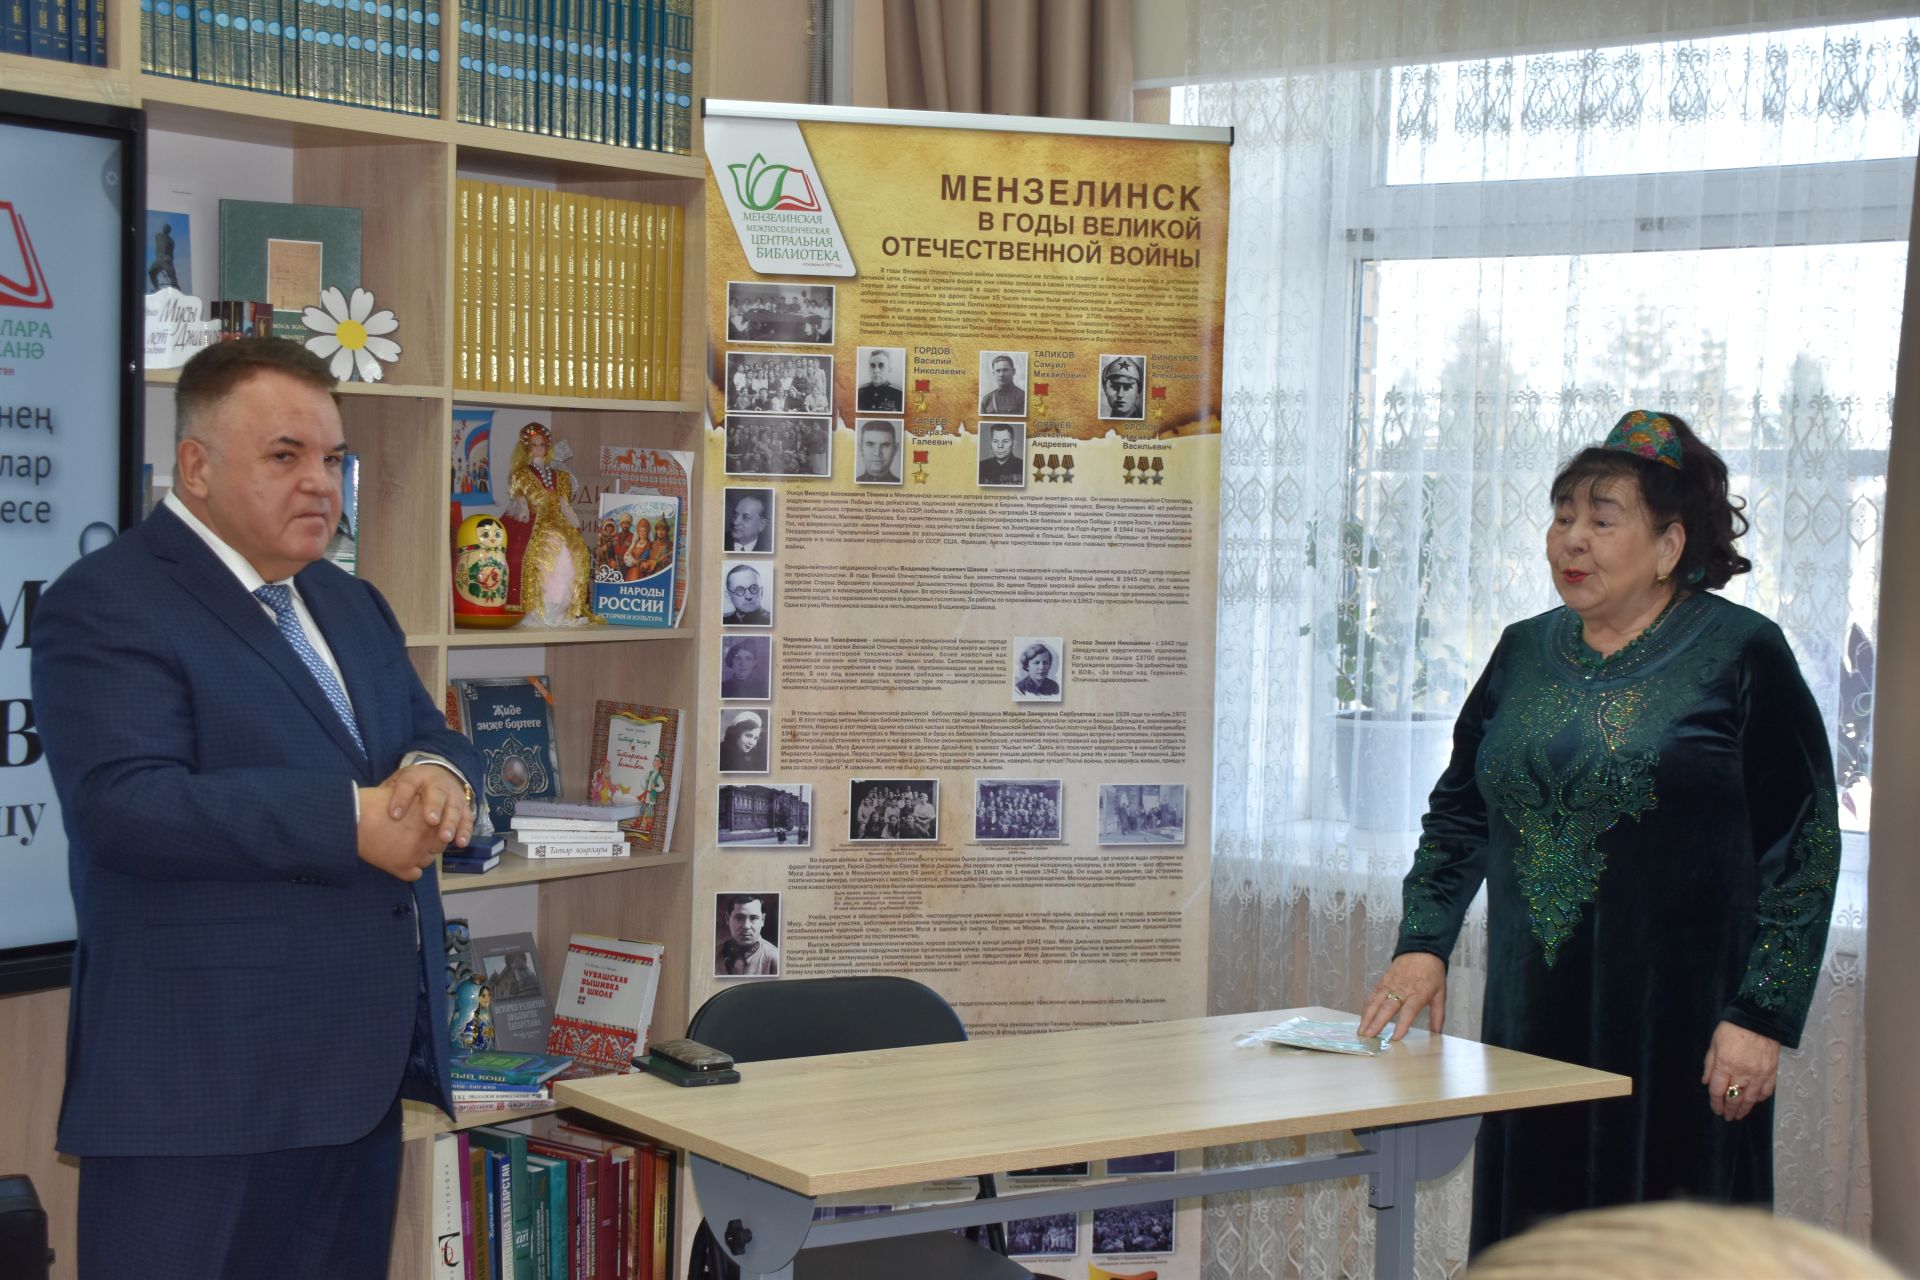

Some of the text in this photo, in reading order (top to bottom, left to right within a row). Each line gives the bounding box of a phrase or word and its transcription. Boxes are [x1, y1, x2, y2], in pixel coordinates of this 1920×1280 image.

[941, 174, 1201, 212] МЕНЗЕЛИНСК
[744, 212, 822, 224] МЕНЗЕЛИНСКАЯ
[746, 225, 830, 235] МЕЖПОСЕЛЕНЧЕСКАЯ
[978, 212, 1201, 241] В ГОДЫ ВЕЛИКОЙ
[752, 235, 832, 248] ЦЕНТРАЛЬНАЯ
[756, 248, 840, 261] БИБЛИОТЕКА
[882, 236, 1201, 269] ОТЕЧЕСТВЕННОЙ ВОЙНЫ
[0, 341, 44, 360] АНӘ
[914, 346, 950, 356] ГОРДОВ
[914, 356, 952, 366] Василий
[1152, 354, 1198, 362] ВИНОКУРОВ
[914, 366, 966, 376] Николаевич
[1034, 361, 1066, 370] Самуил
[912, 438, 953, 448] Галеевич
[1032, 440, 1077, 450] Андреевич
[1122, 442, 1172, 451] Васильевич
[620, 586, 664, 597] НАРОДЫ
[598, 597, 664, 612] РОССИИ
[550, 846, 574, 856] Татар
[584, 969, 629, 984] ЧУВАШСКАЯ
[582, 978, 619, 991] ВЫШИВКА
[587, 988, 614, 998] ШКОЛЕ
[501, 1164, 512, 1218] ТАТАРСТАН
